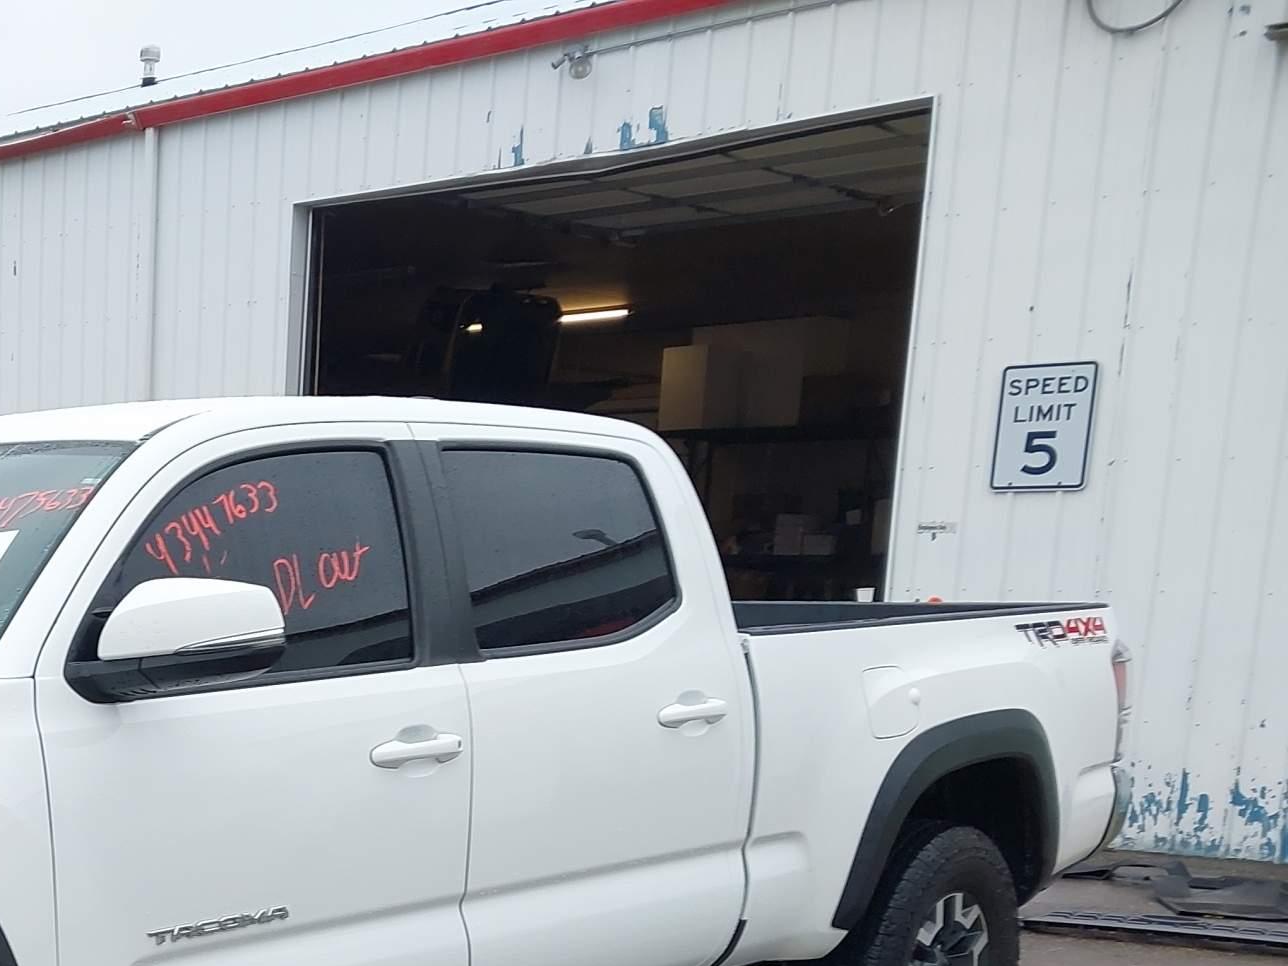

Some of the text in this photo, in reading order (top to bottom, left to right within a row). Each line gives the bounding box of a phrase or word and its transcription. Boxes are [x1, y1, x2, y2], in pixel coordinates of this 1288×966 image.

[1008, 375, 1090, 396] SPEED
[1013, 403, 1077, 423] LIMIT
[1020, 430, 1058, 475] 5
[144, 480, 279, 575] 43447633
[145, 905, 289, 946] TACOMA
